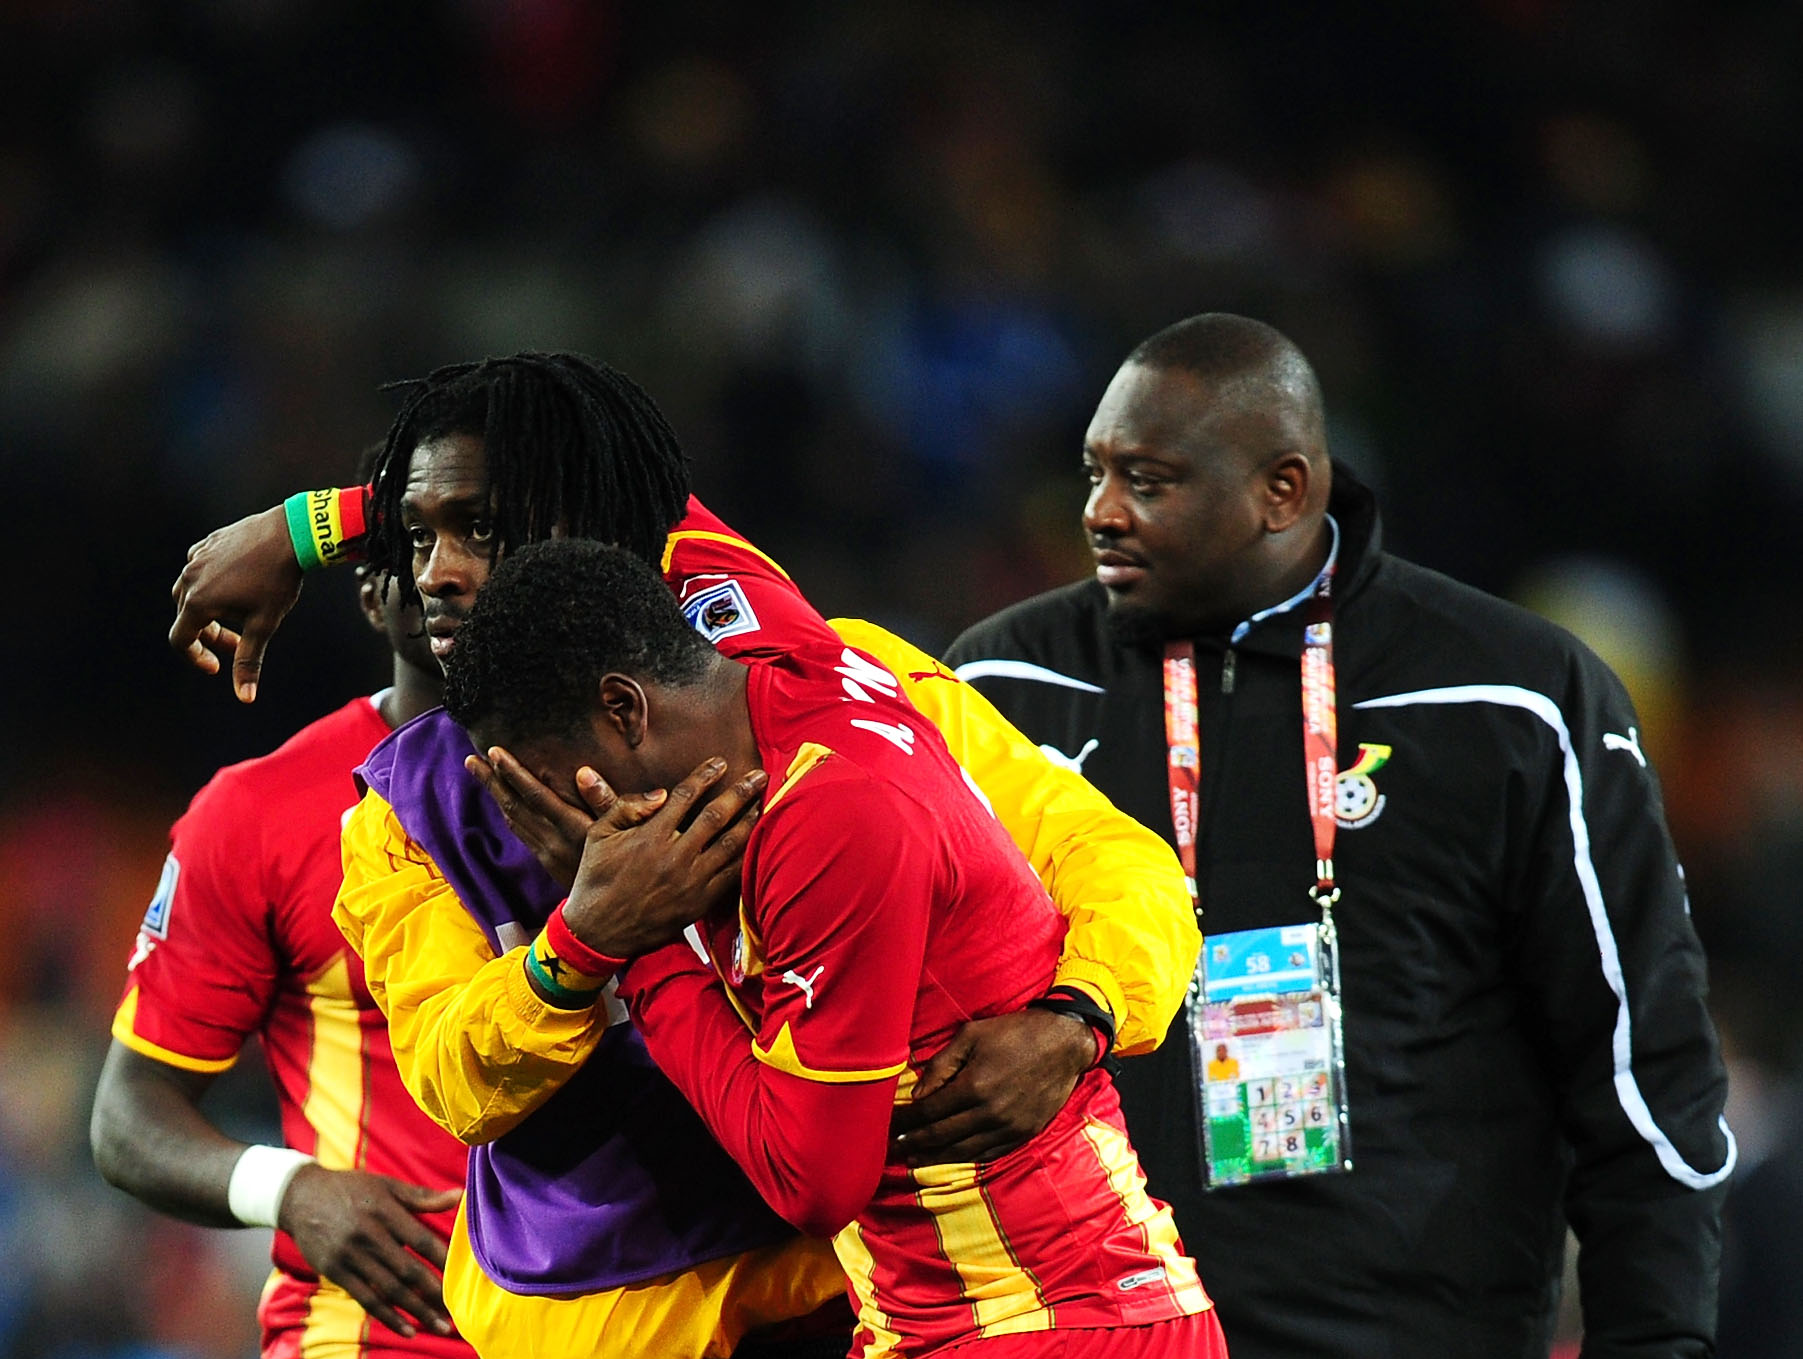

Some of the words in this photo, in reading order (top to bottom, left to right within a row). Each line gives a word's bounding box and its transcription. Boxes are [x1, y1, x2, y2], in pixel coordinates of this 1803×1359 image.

[1318, 756, 1335, 819] SONY
[1173, 786, 1191, 846] SONY
[1247, 954, 1271, 974] 58
[1256, 1085, 1265, 1101] 1
[1284, 1082, 1294, 1098] 2
[1285, 1109, 1295, 1126] 5
[1311, 1106, 1321, 1122] 6
[1260, 1139, 1269, 1155] 7
[1286, 1136, 1297, 1152] 8
